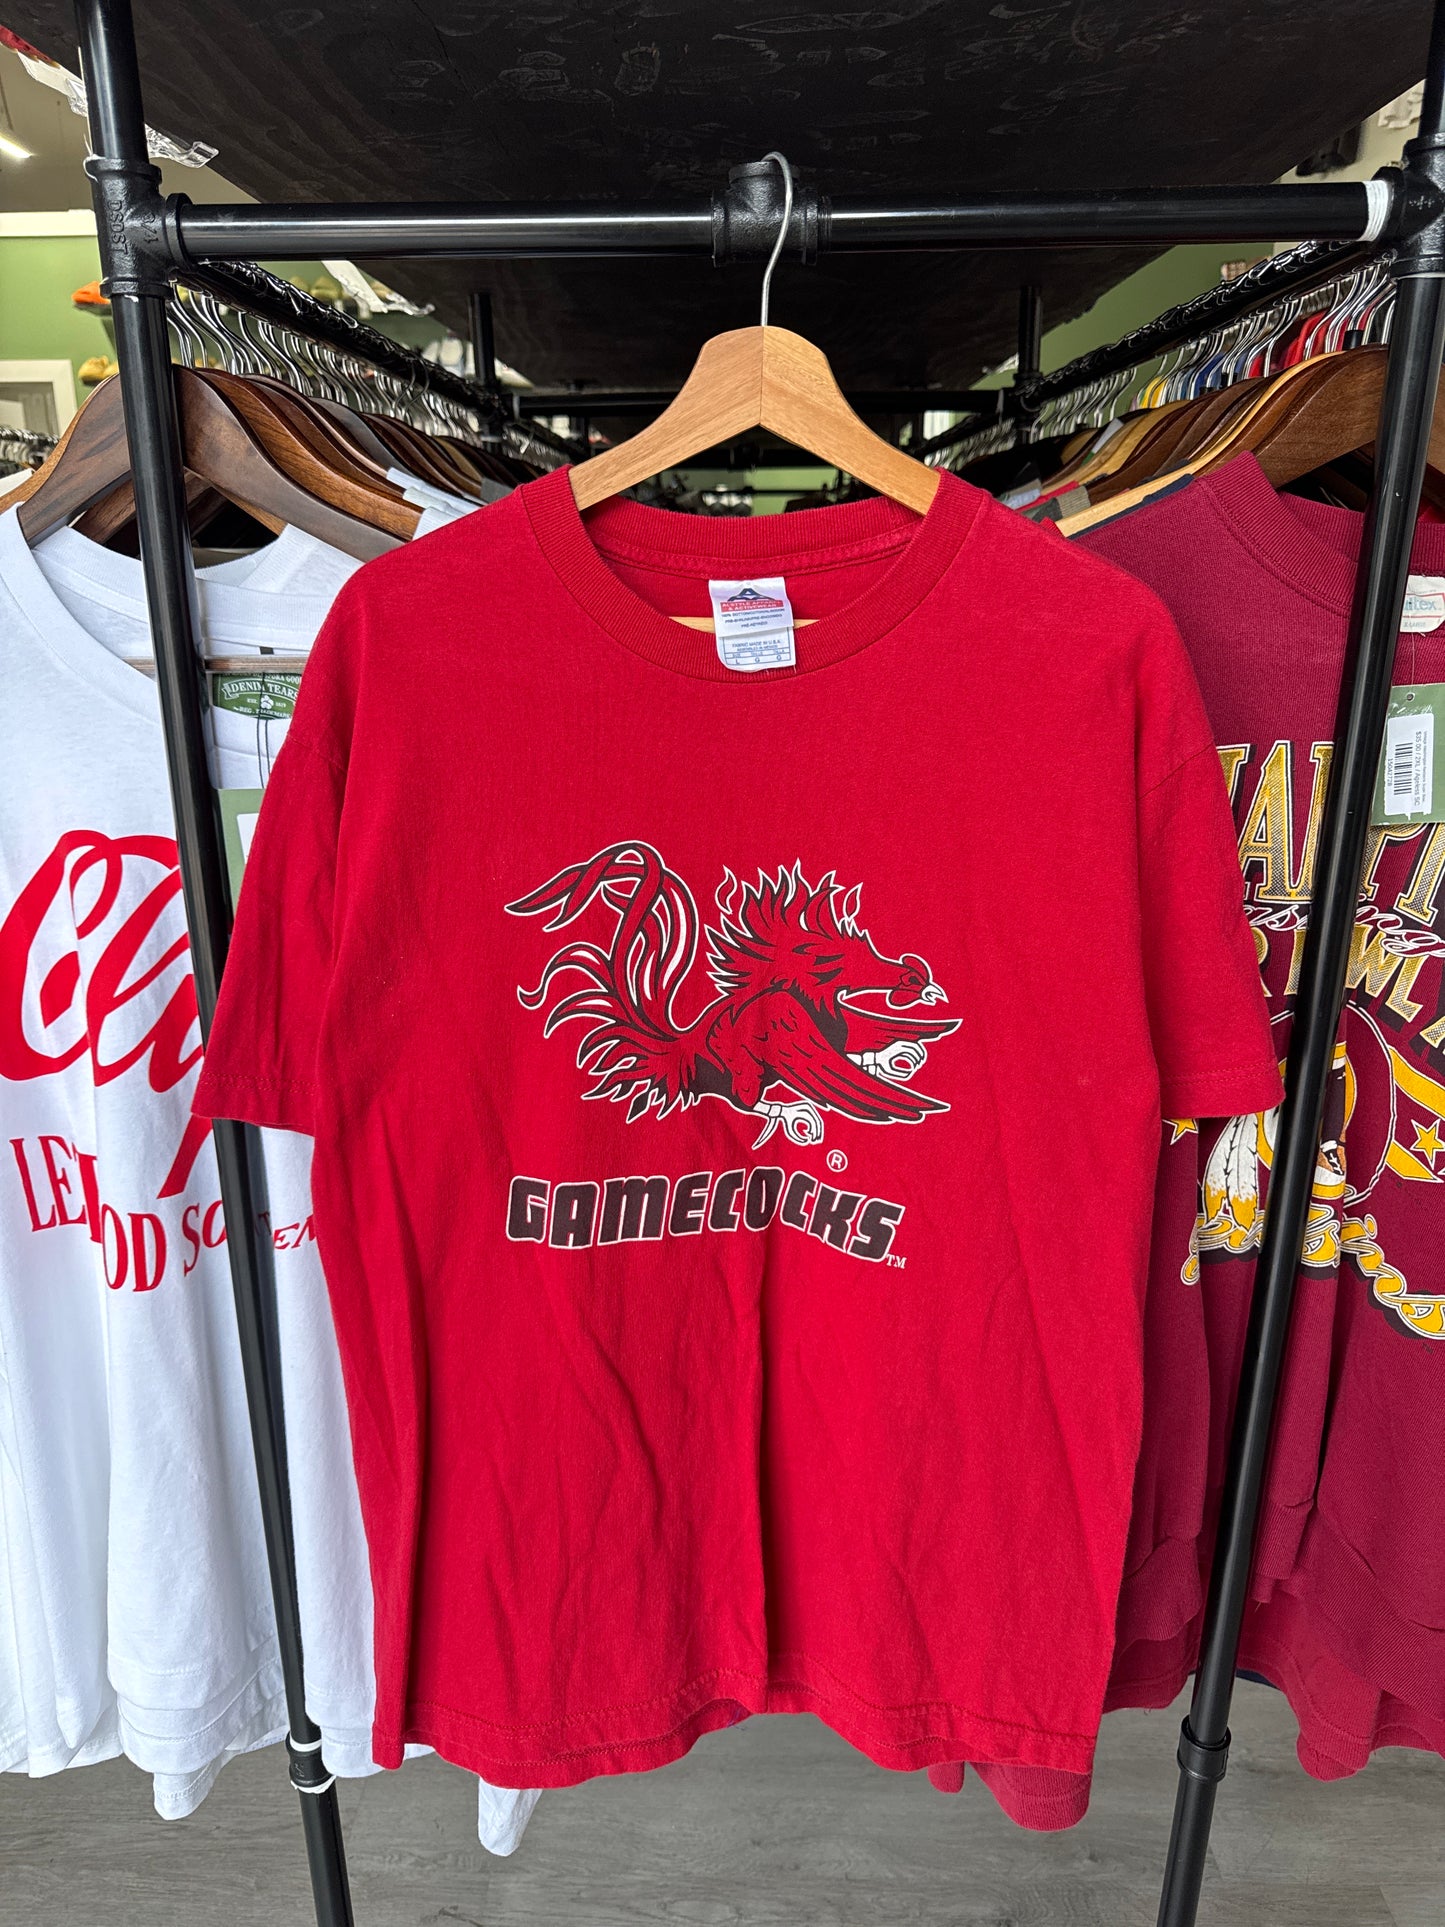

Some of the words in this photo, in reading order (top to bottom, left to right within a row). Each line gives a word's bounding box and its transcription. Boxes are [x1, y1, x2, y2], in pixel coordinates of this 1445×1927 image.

[108, 200, 128, 255] DSDST
[102, 1202, 167, 1292] OD
[506, 1166, 905, 1263] GAMECOCKS
